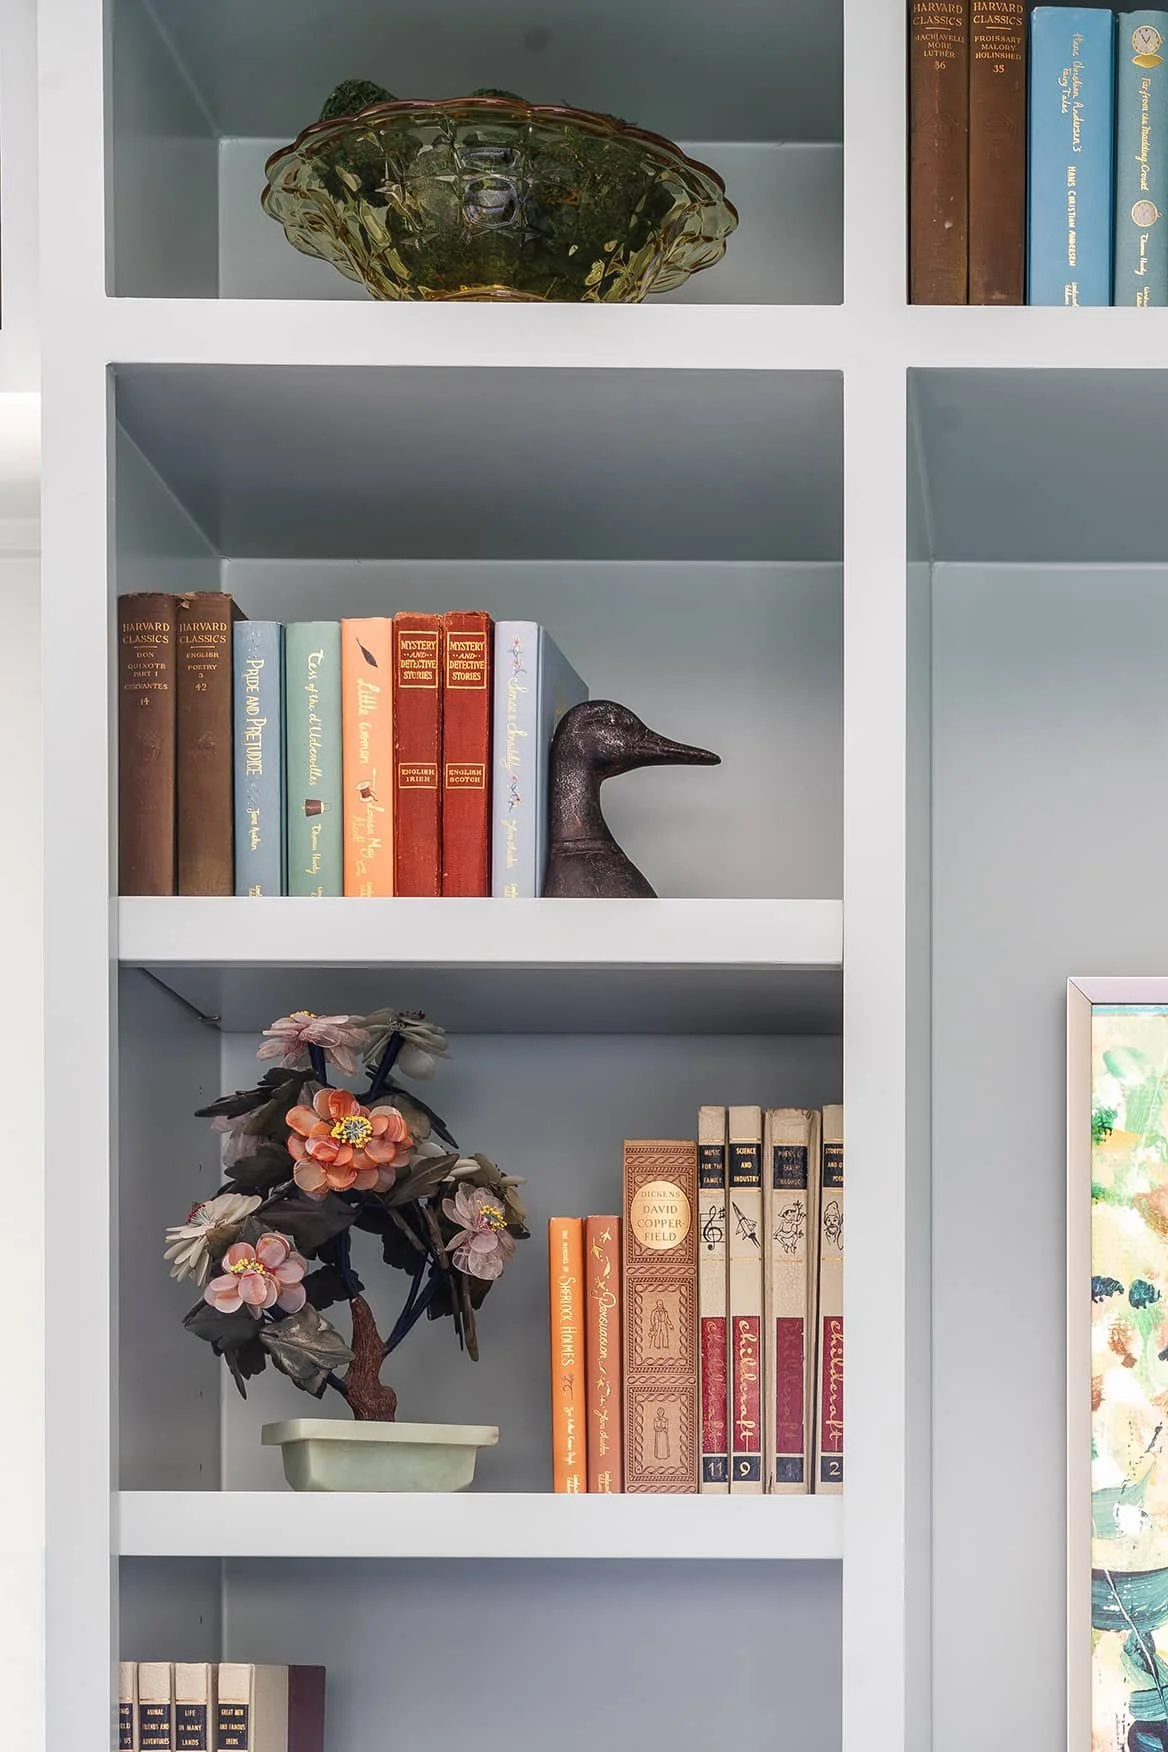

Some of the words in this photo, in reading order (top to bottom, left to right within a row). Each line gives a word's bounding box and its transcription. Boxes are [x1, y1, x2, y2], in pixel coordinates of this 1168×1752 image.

[913, 2, 963, 14] HARVARD
[973, 2, 1023, 13] HARVARD
[912, 16, 962, 26] CLASSICS
[973, 15, 1023, 25] CLASSICS
[993, 64, 1005, 73] 35
[1067, 166, 1076, 187] HANS
[122, 622, 170, 632] HARVARD
[179, 622, 227, 632] HARVARD
[122, 634, 169, 644] CLASSICS
[179, 634, 226, 644] CLASSICS
[400, 640, 437, 650] MYSTERY
[450, 641, 485, 651] MYSTERY
[307, 648, 324, 680] Tess
[400, 659, 437, 669] DETECTIVE
[449, 660, 485, 670] DETECTIVE
[403, 671, 433, 680] STORIES
[452, 672, 481, 681] STORIES
[358, 678, 381, 715] Little
[246, 695, 260, 715] AND
[736, 1147, 757, 1155] SCIENCE
[740, 1161, 753, 1169] AND
[733, 1175, 759, 1183] INDUSTRY
[642, 1205, 678, 1214] DAVID
[644, 1232, 677, 1241] FIELD
[558, 1276, 576, 1321] SHERLOCK
[592, 1292, 617, 1359] Persuasion
[560, 1326, 577, 1367] HOLMES
[735, 1320, 758, 1452] childcraft
[825, 1320, 843, 1452] childcraft
[708, 1462, 722, 1477] 11
[740, 1461, 751, 1477] 9
[829, 1461, 841, 1476] 2
